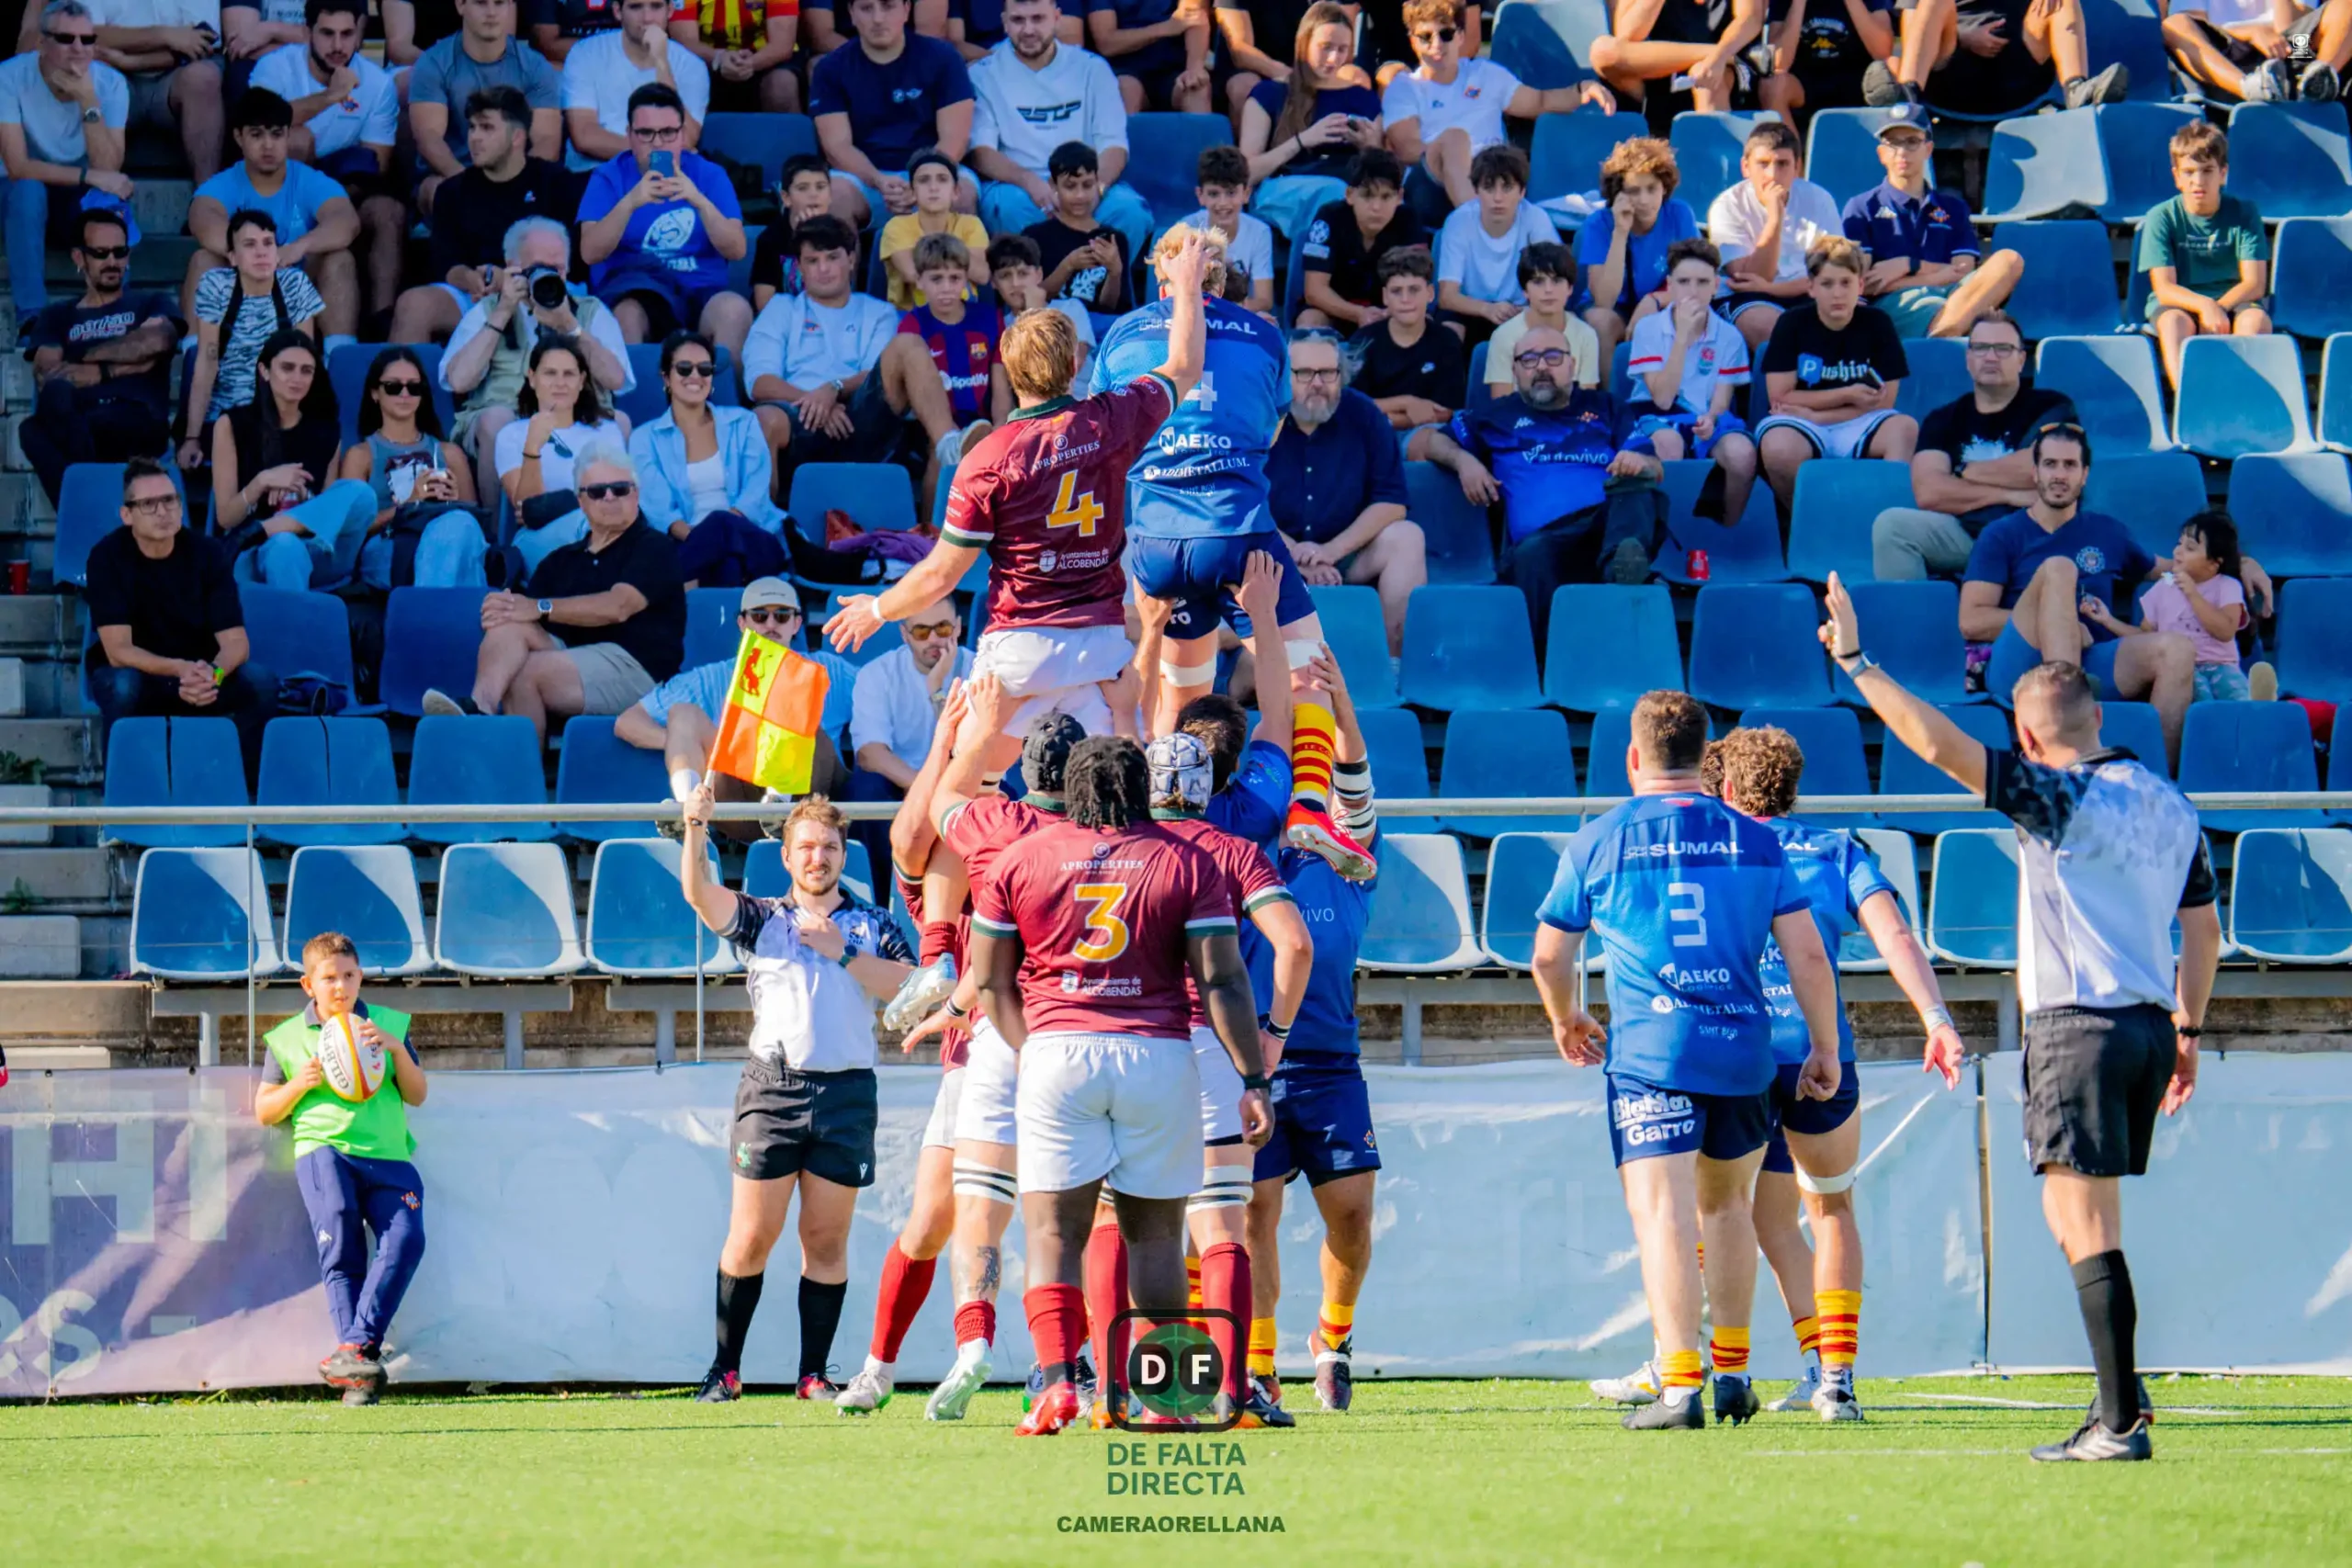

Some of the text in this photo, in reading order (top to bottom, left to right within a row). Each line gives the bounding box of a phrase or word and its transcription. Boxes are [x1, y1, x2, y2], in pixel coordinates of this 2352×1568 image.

[1046, 468, 1104, 537] 4
[1057, 556, 1110, 570] ALCOBENDAS
[1649, 841, 1744, 857] SUMAL
[1060, 860, 1145, 872] APROPERTIES
[1072, 882, 1130, 963] 3
[1668, 882, 1707, 947] 3
[1080, 986, 1142, 997] ALCOBENDAS
[1627, 1119, 1696, 1147] Garro
